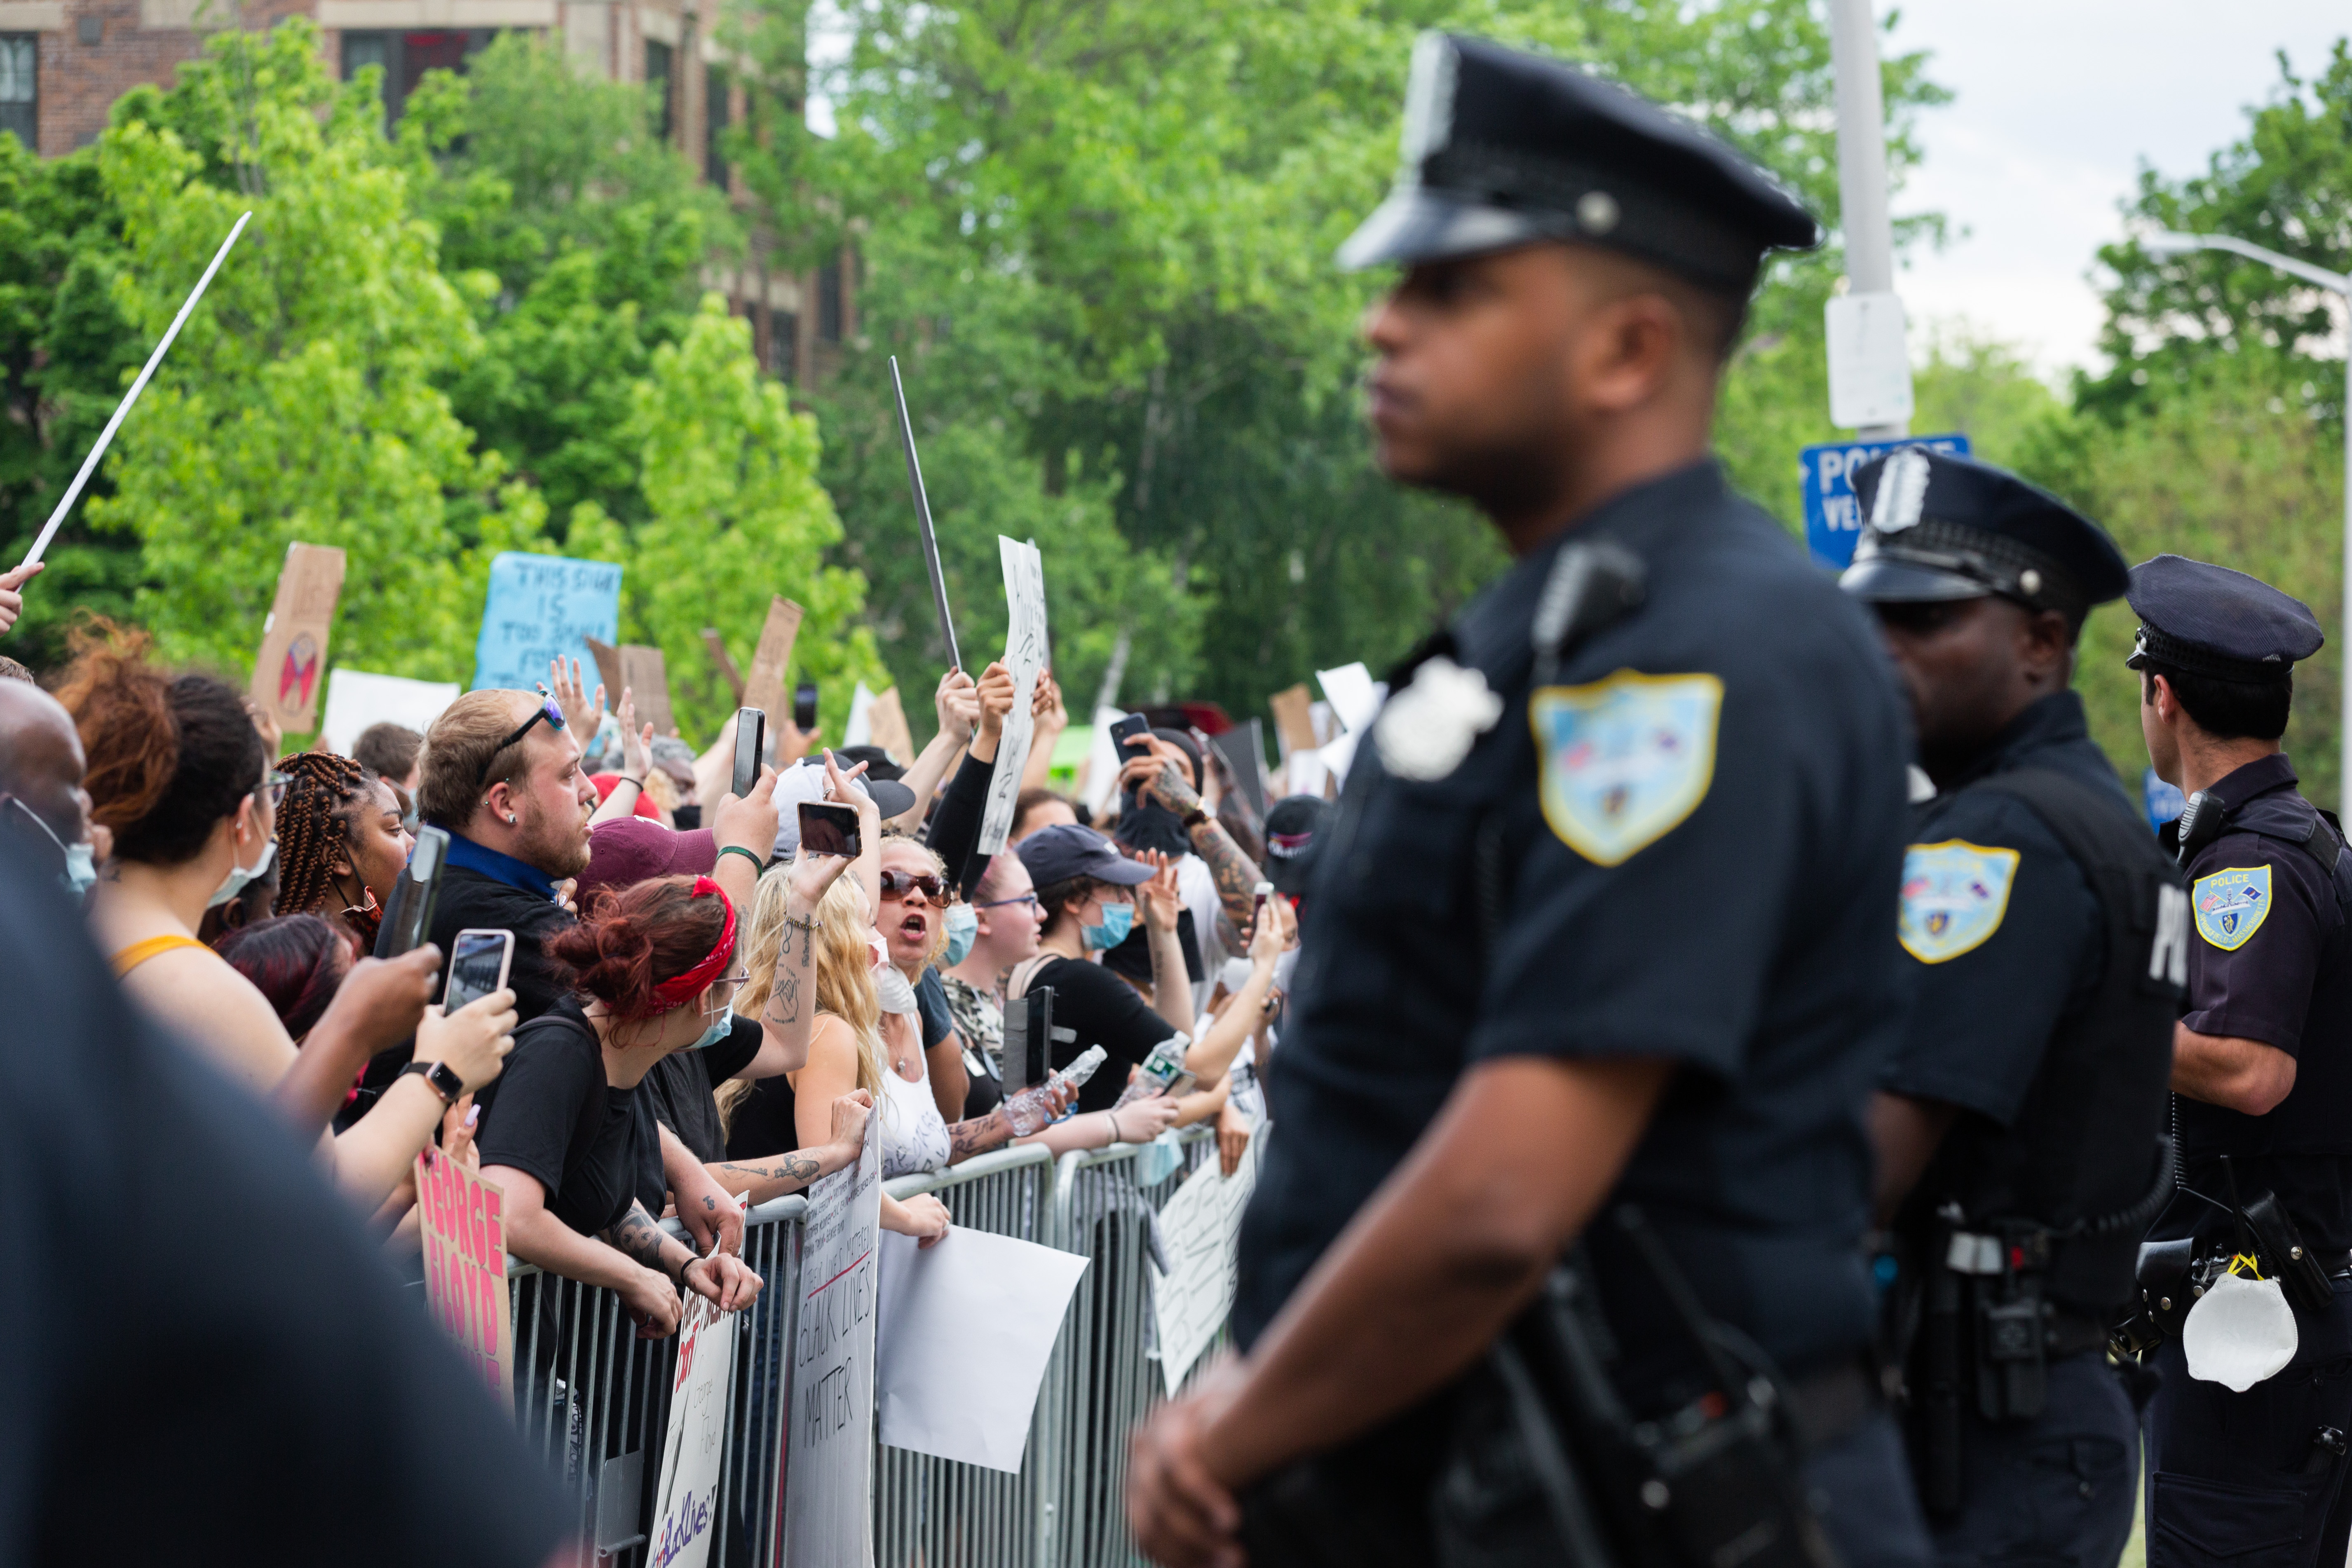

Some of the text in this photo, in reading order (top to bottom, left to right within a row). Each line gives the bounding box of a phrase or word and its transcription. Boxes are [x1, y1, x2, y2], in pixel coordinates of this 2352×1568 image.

[537, 593, 565, 623] IS
[2211, 874, 2249, 889] POLICE
[2200, 899, 2266, 945] SPRINGFIELD MASSACHUSETTS
[419, 1150, 504, 1277] GEORGE
[825, 1247, 842, 1282] LIVES
[846, 1220, 874, 1267] MATTERED!!
[1179, 1175, 1224, 1331] LIVES
[429, 1235, 498, 1356] FLOYD
[799, 1285, 836, 1367] BLACK
[842, 1261, 870, 1337] LIVES
[694, 1355, 713, 1416] George
[804, 1357, 852, 1449] MATTER
[700, 1416, 717, 1463] Floyd
